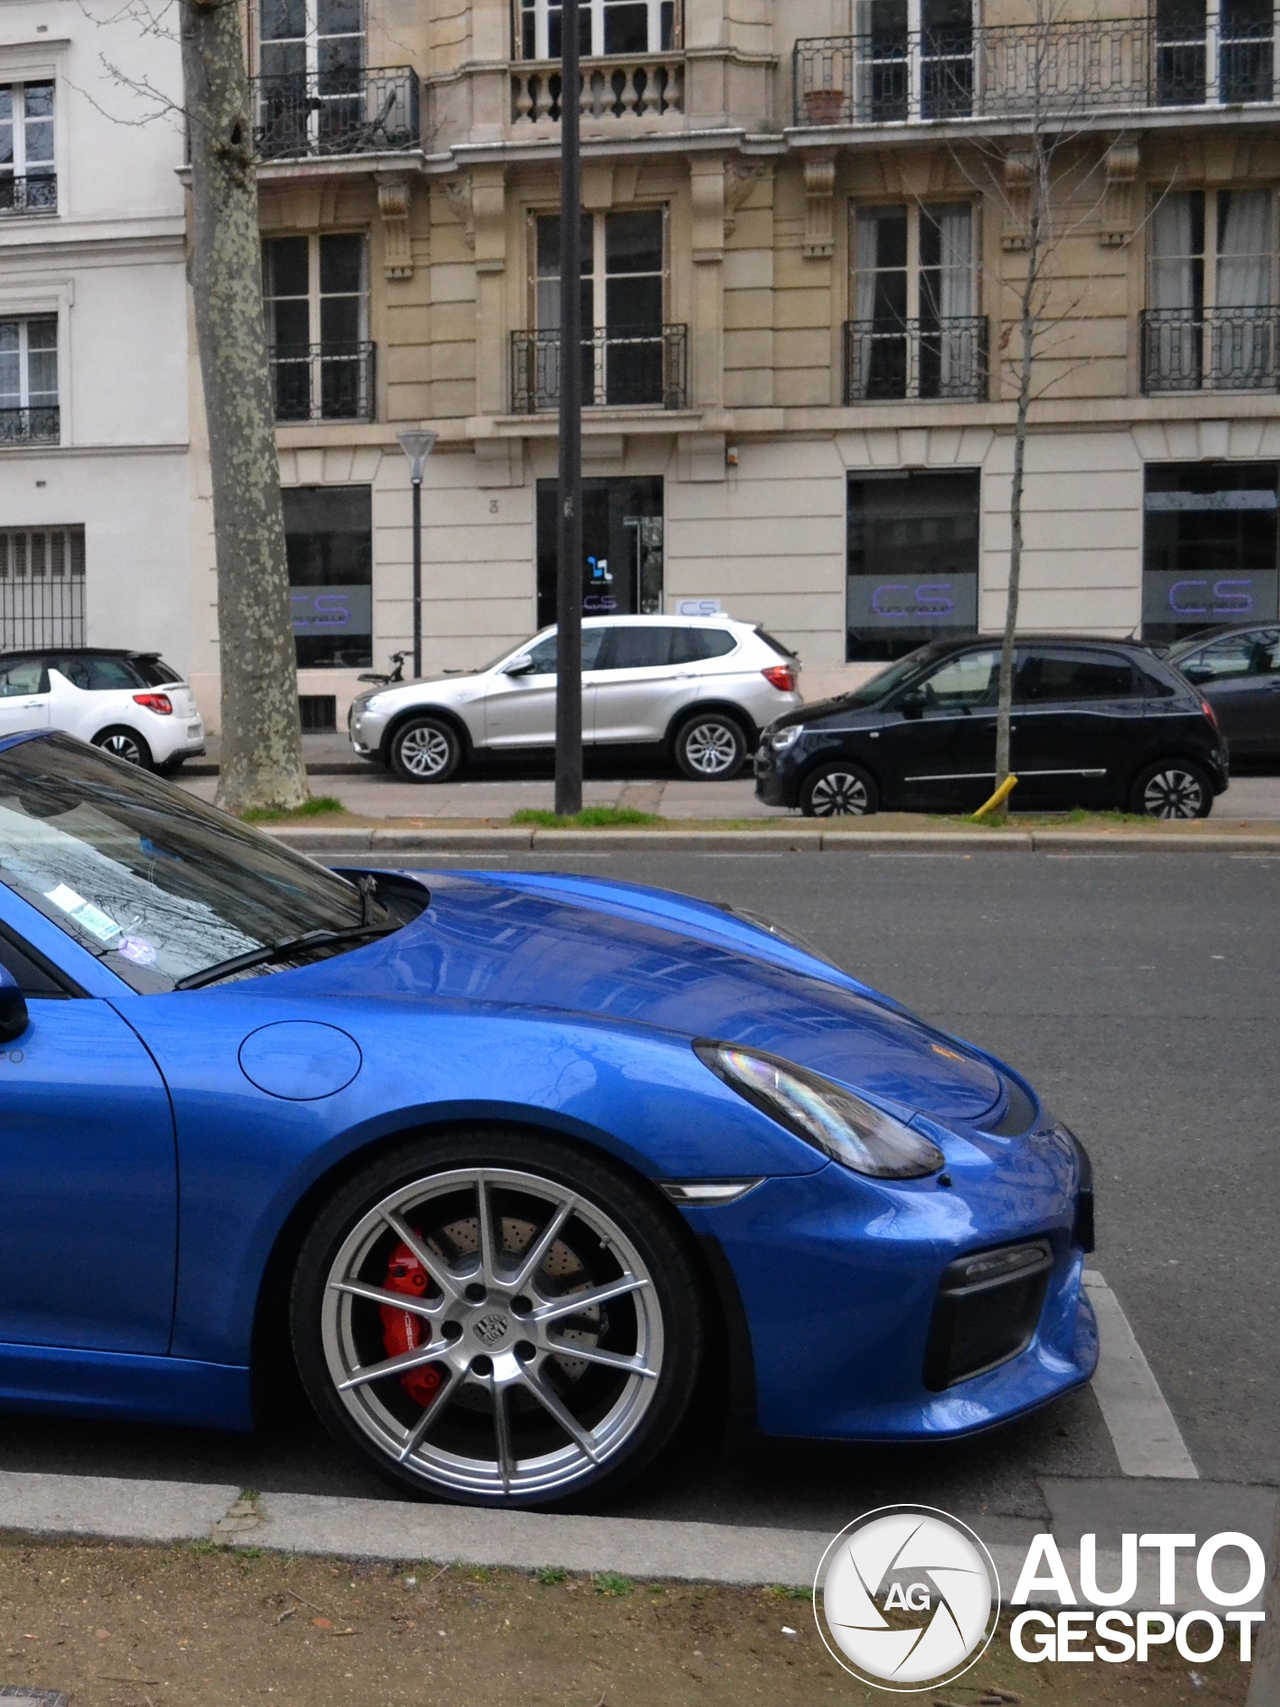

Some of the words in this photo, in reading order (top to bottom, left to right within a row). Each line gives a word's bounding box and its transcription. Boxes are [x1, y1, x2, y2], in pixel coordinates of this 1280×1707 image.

[489, 499, 499, 514] 3
[584, 595, 617, 610] CS
[872, 584, 954, 616] CS
[1168, 580, 1253, 613] CS
[680, 601, 717, 616] CS
